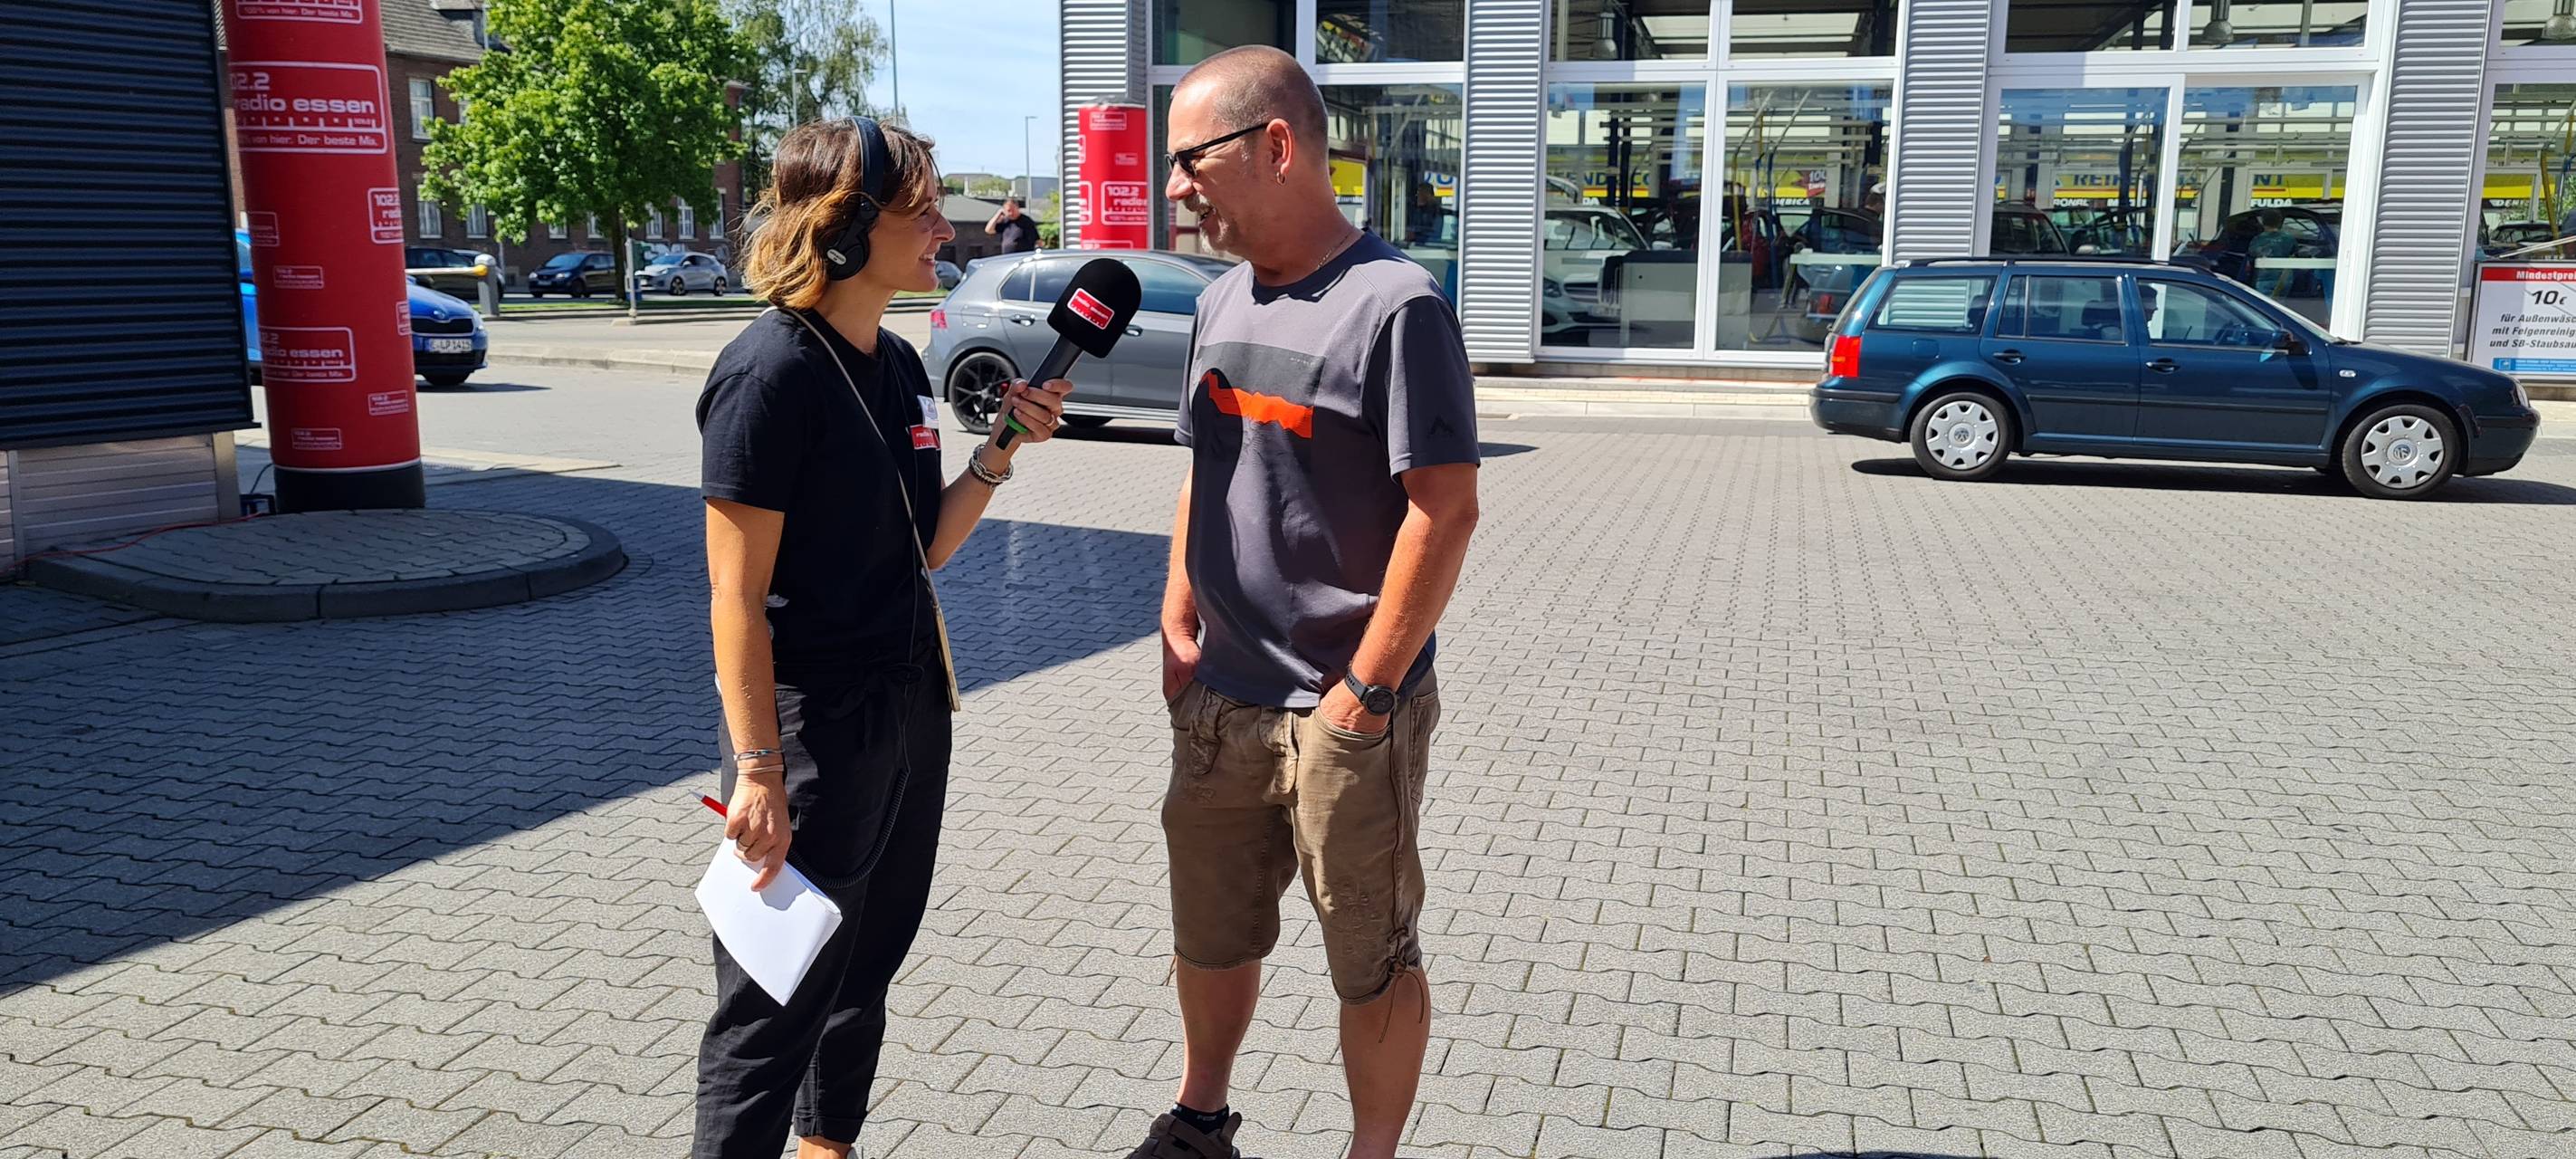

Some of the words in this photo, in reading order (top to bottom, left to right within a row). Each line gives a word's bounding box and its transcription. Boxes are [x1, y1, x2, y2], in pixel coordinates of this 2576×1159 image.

[234, 93, 286, 111] radio
[292, 97, 376, 114] essen
[298, 134, 320, 146] Der
[323, 135, 357, 147] beste
[1106, 186, 1140, 196] 102.2
[2249, 197, 2294, 208] FULDA
[2500, 313, 2516, 323] für
[2492, 326, 2510, 336] mit
[2489, 339, 2510, 348] und
[289, 349, 344, 359] essen
